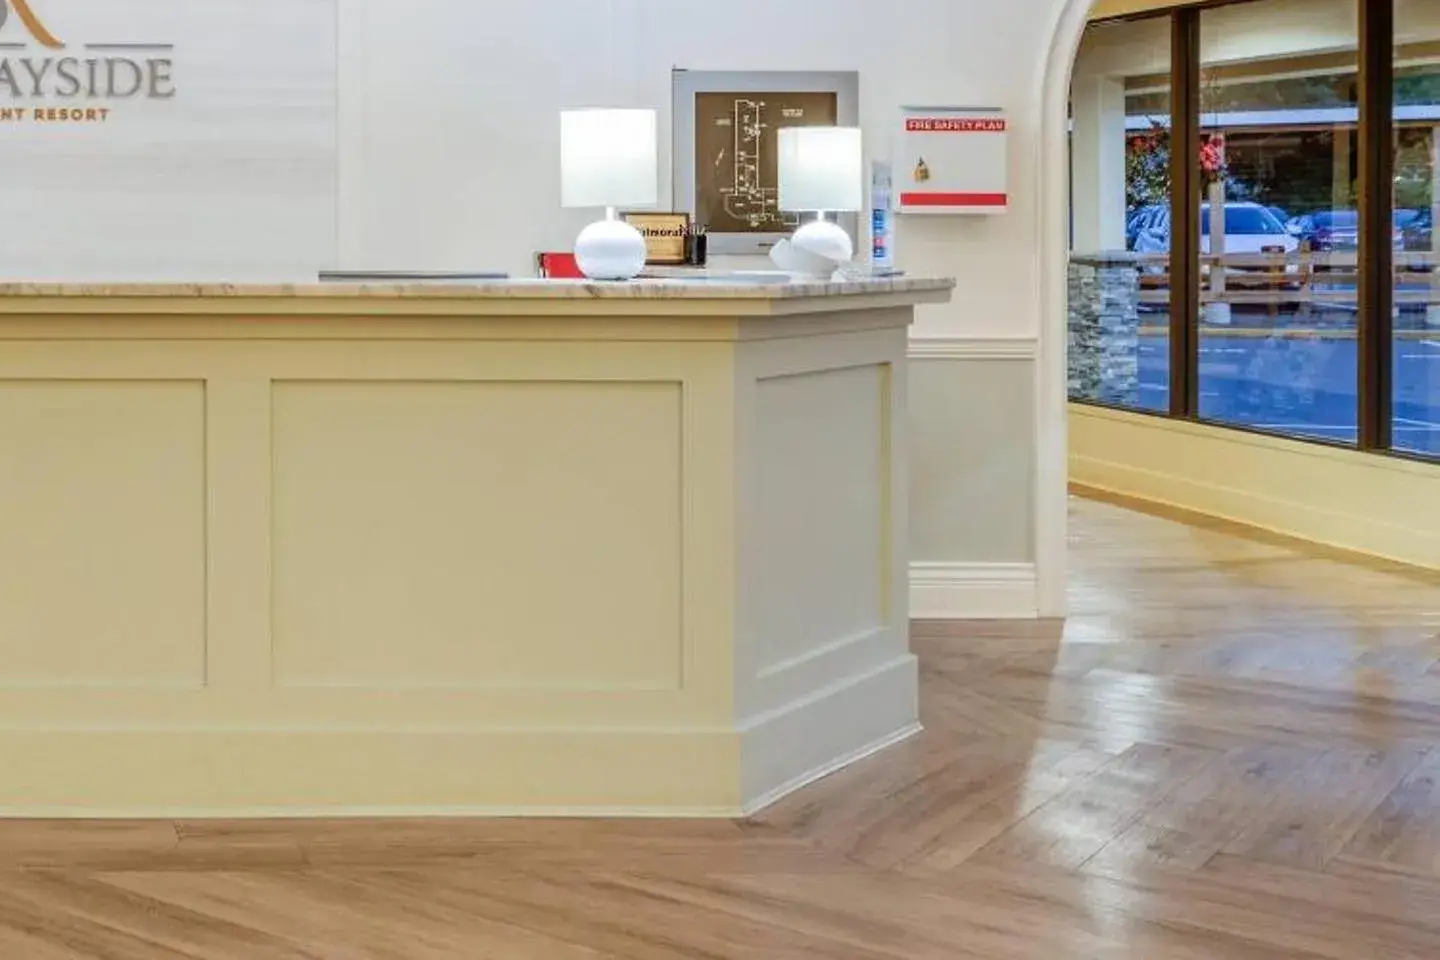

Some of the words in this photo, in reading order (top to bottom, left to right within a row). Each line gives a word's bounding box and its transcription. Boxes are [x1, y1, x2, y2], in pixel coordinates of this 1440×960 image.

[34, 107, 110, 121] RESORT
[909, 120, 932, 130] FIRE
[934, 120, 973, 130] SAFETY
[974, 120, 1004, 130] PLAN
